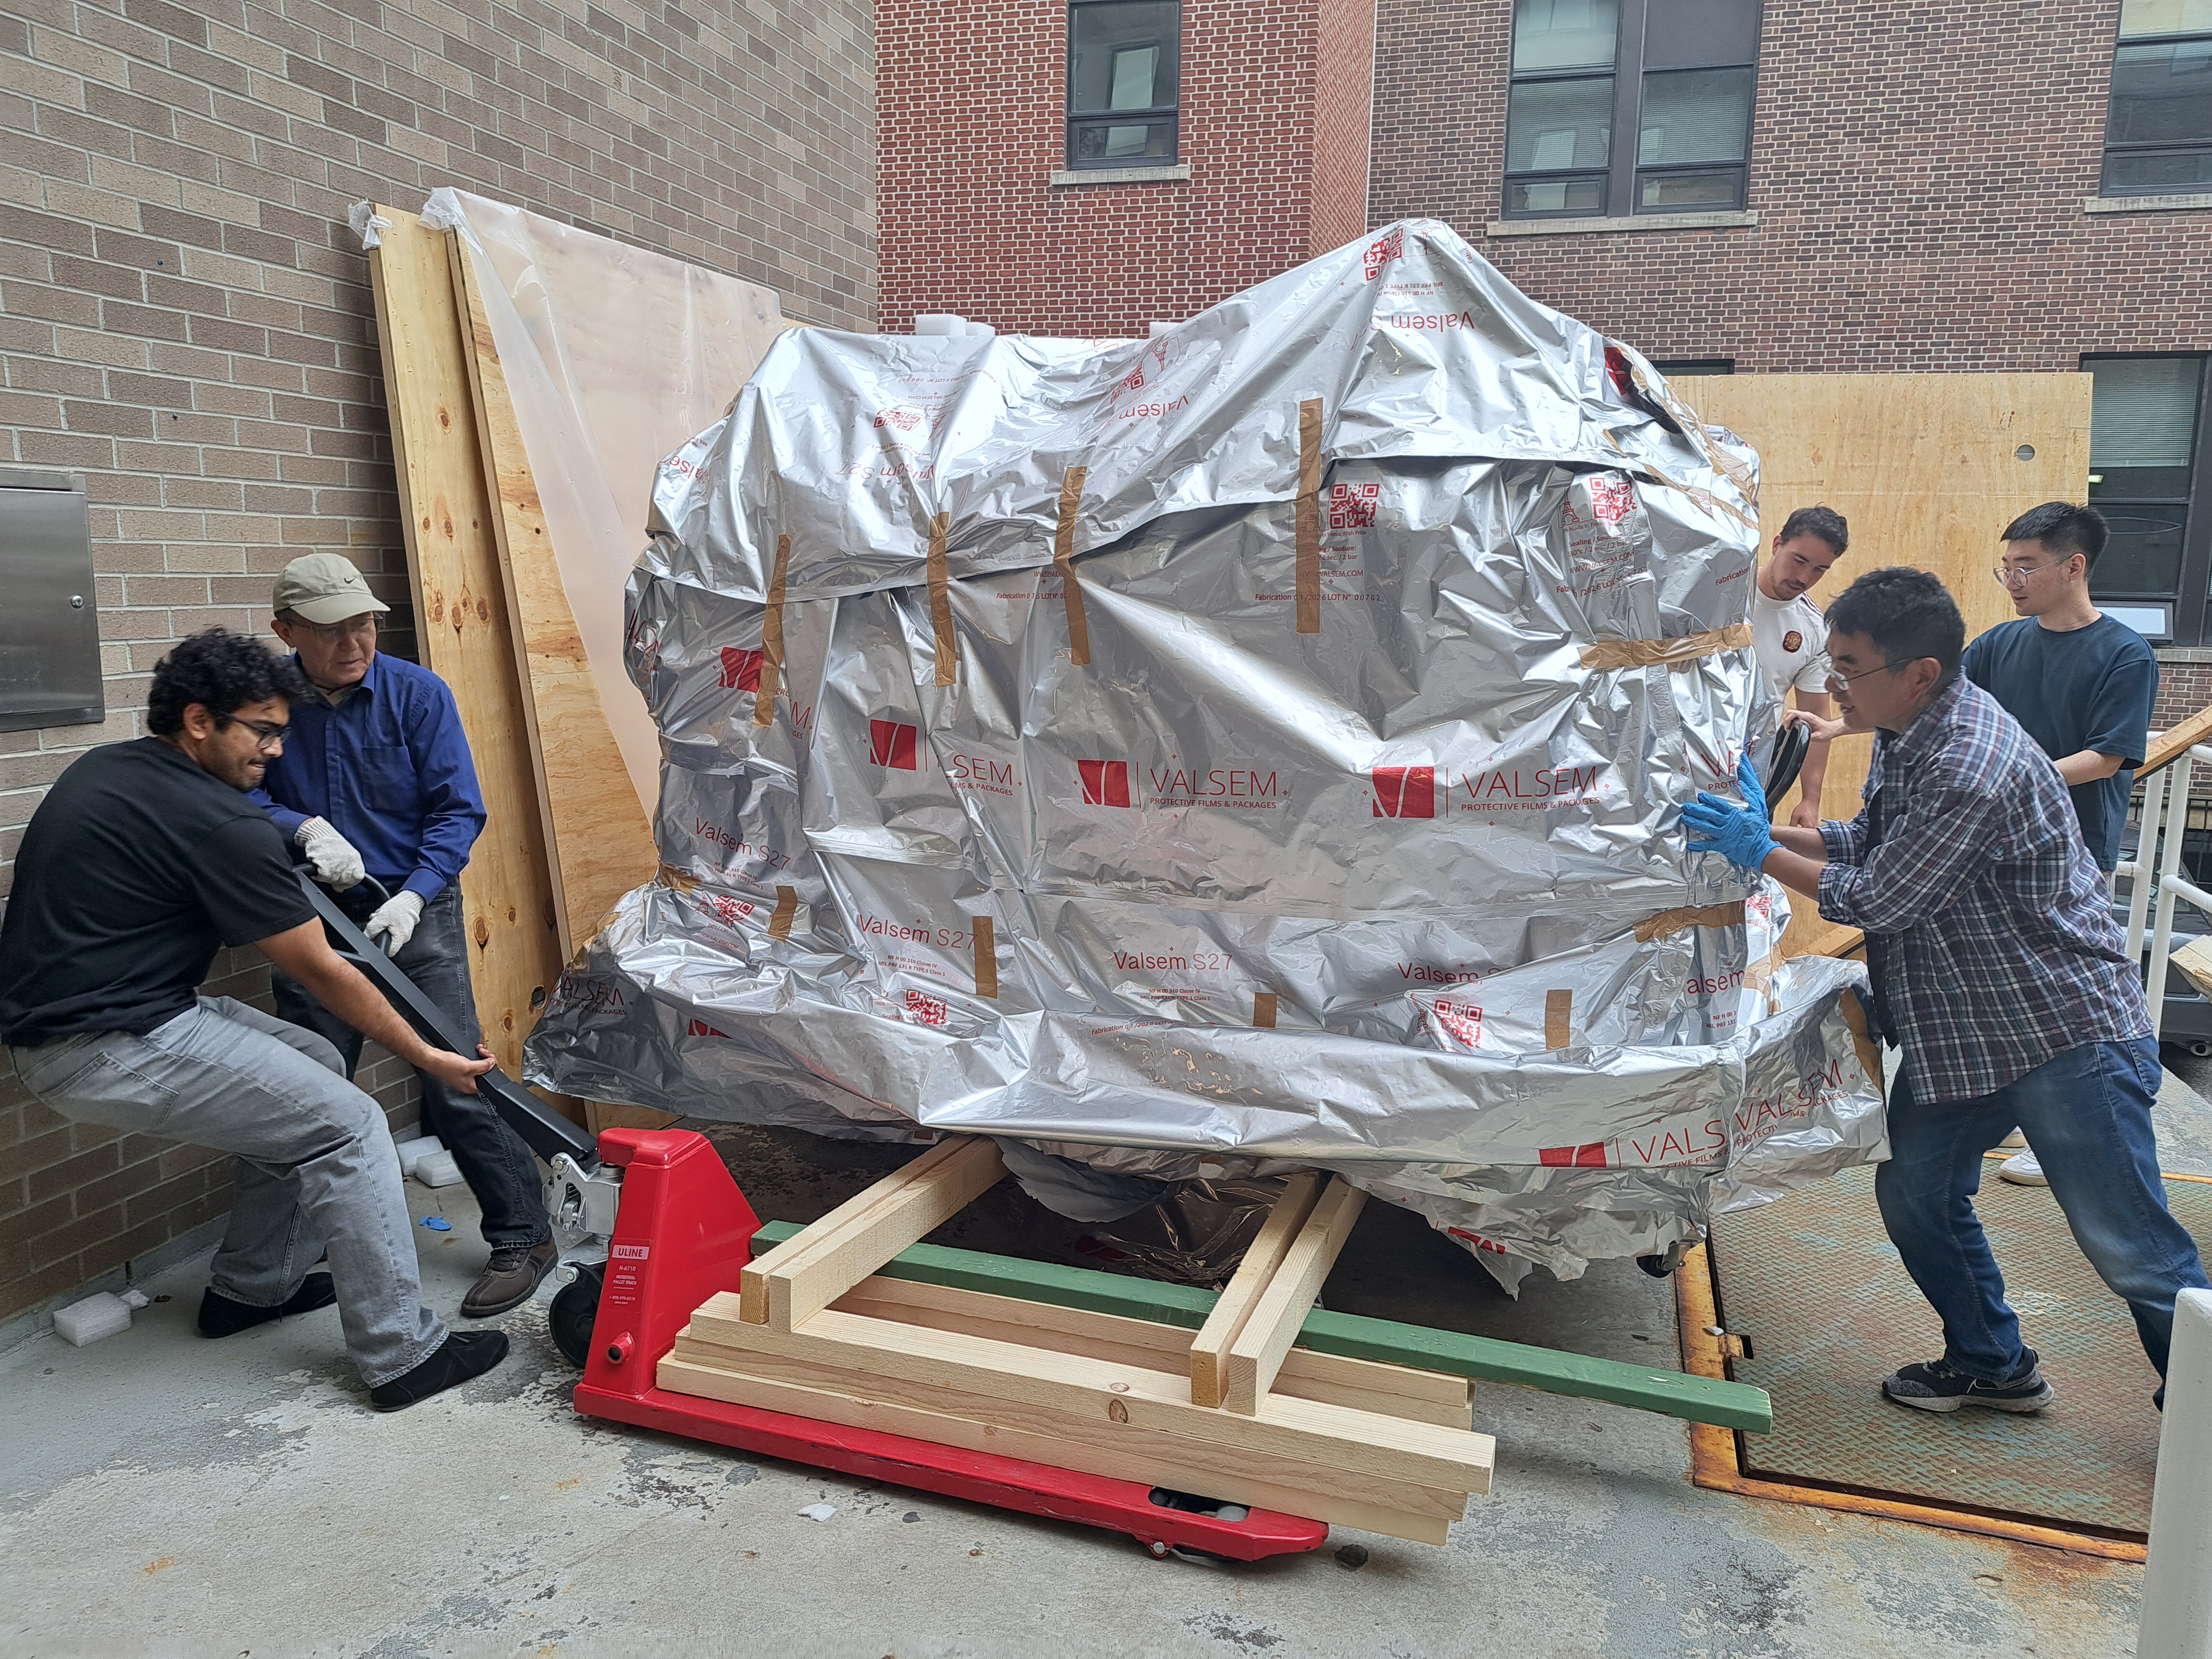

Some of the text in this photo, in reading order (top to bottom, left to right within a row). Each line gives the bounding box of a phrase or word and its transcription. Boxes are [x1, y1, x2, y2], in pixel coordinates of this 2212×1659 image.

[1391, 311, 1475, 332] Valsem
[1118, 395, 1189, 420] Valsem
[1569, 539, 1593, 548] Sealing
[946, 754, 1012, 786] SEM
[976, 783, 1014, 796] PACKAGES
[1150, 768, 1276, 797] VALSEM
[1462, 765, 1597, 798] VALSEM
[1708, 779, 1741, 791] PROTEC
[1150, 797, 1196, 807] PROTECTIVE
[1233, 801, 1277, 809] PACKAGES
[1461, 803, 1519, 811] PROTECTIVE
[1522, 801, 1548, 810] FILMS
[1558, 796, 1600, 808] PACKAGES
[696, 817, 791, 871] Valsem S27
[737, 874, 747, 882] TYPE
[859, 914, 978, 950] Valsem S27
[1113, 951, 1234, 971] Valsem S27
[1397, 962, 1479, 984] Valsem
[1686, 970, 1746, 994] alsem
[1092, 1025, 1123, 1035] Fabrication
[1735, 1059, 1843, 1131] VALSEM
[1813, 1090, 1849, 1108] ACKAGES
[1632, 1119, 1725, 1164] VALS
[1737, 1124, 1778, 1147] PROTECTI
[1696, 1150, 1722, 1163] FILMS
[618, 1248, 643, 1257] ULINE
